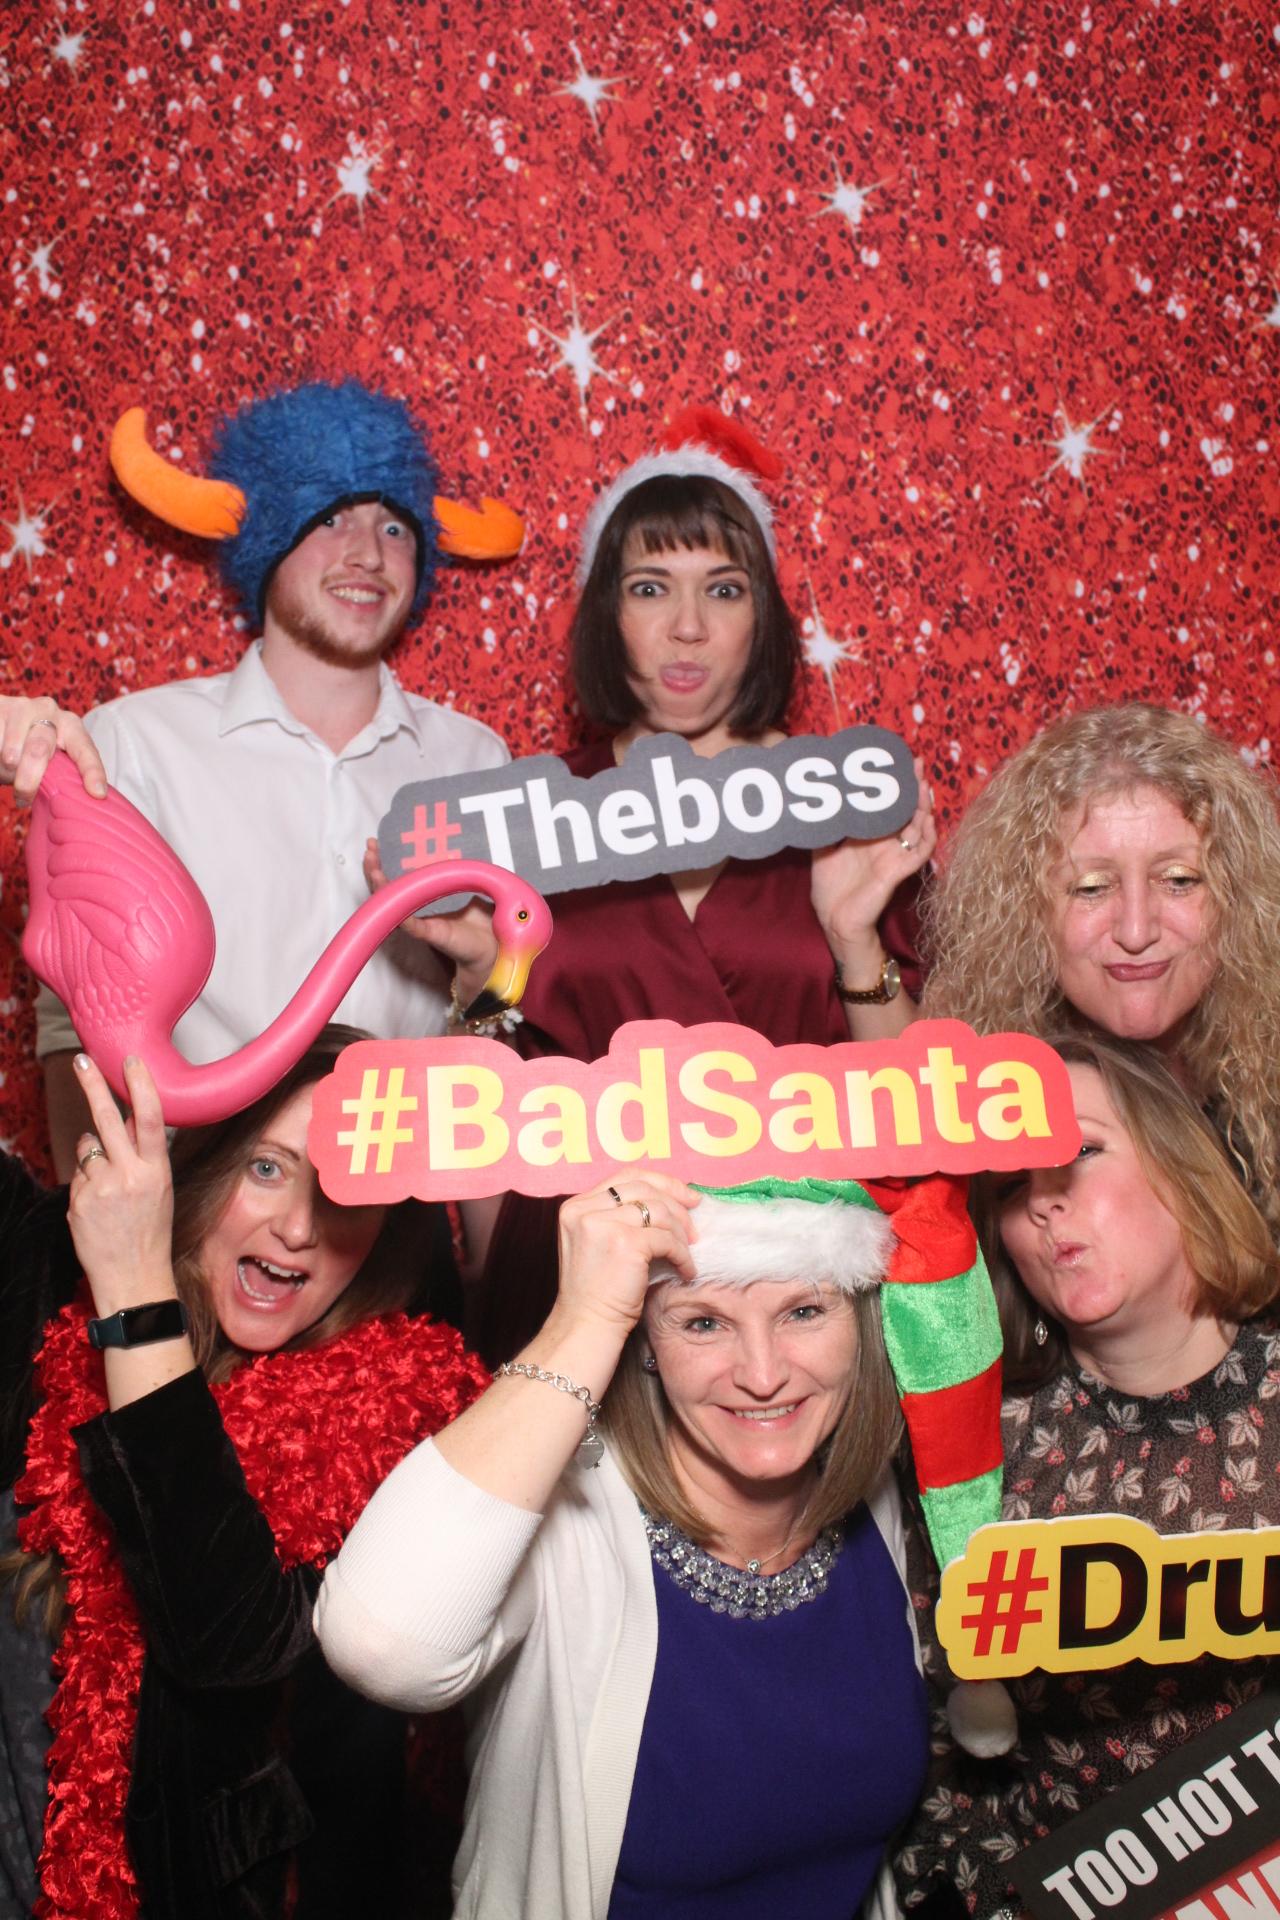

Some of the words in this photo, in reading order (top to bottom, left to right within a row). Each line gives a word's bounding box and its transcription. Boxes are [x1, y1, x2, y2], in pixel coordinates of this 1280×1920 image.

[400, 746, 900, 874] #Theboss
[336, 1046, 1052, 1176] #BadSanta
[1042, 1828, 1158, 1920] TOO
[1141, 1754, 1259, 1863] HOT
[1240, 1717, 1280, 1785] T
